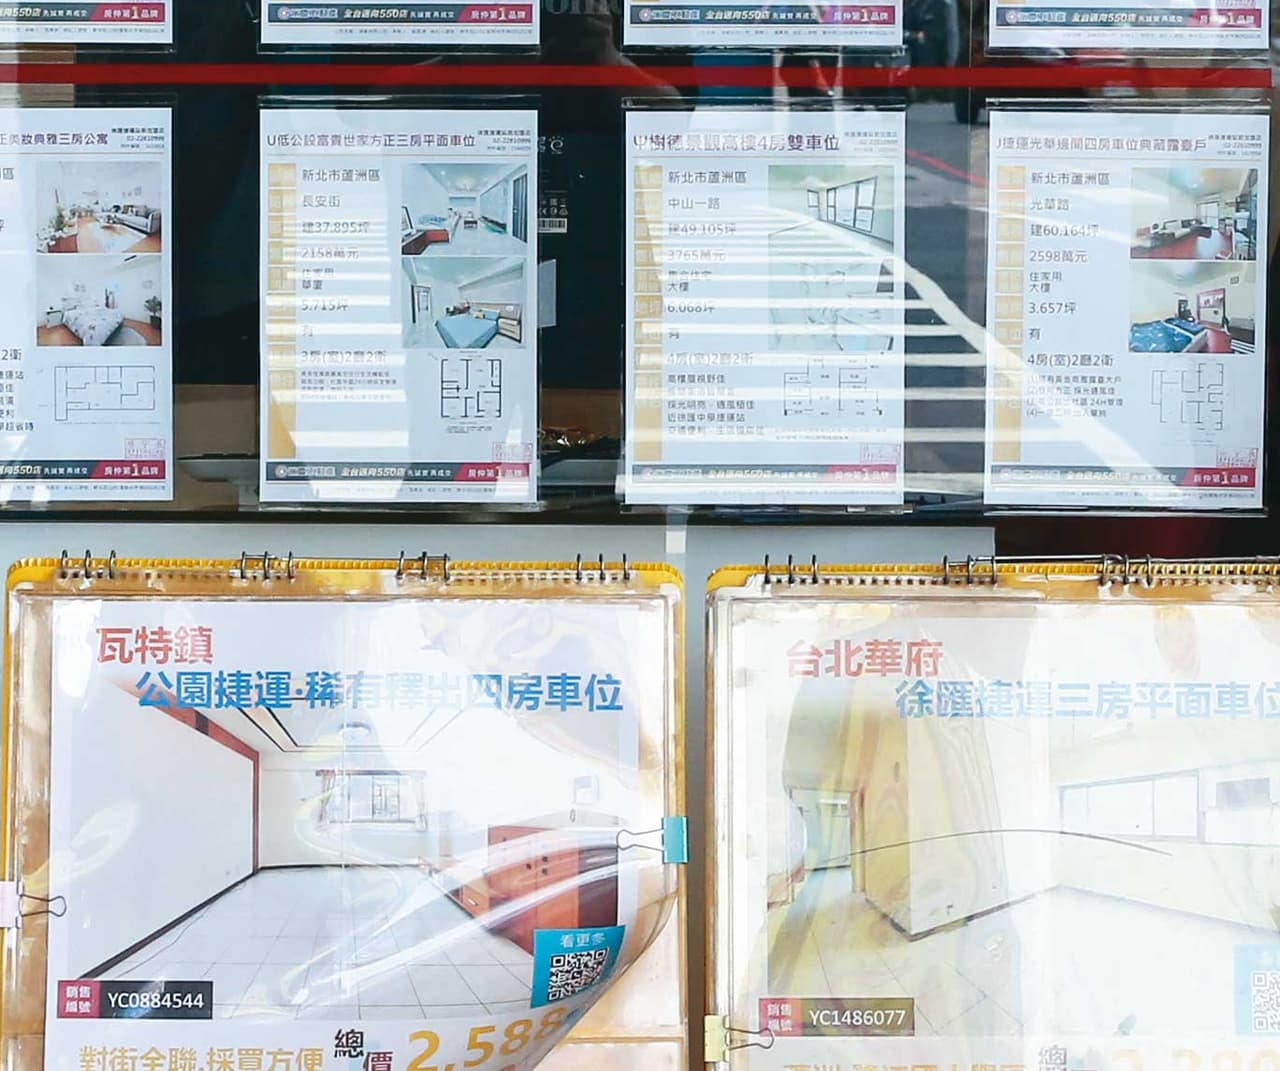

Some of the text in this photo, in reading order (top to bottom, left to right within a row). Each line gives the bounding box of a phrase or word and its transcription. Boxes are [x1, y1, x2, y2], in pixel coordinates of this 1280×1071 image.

[302, 169, 380, 182] 新北市蘆洲區
[668, 171, 746, 184] 新北市蘆洲區
[1031, 173, 1110, 185] 新北市蘆洲區
[668, 197, 720, 209] 中山一路
[1030, 199, 1069, 211] 光華路
[1030, 251, 1087, 263] 2598萬元
[1028, 302, 1076, 315] 3.657坪
[1027, 354, 1113, 367] 4房(室)2廳2衛
[97, 626, 214, 665] 瓦特鎮
[785, 639, 944, 678] 台北華府
[107, 992, 204, 1010] YC0884544
[808, 1008, 906, 1026] YC1486077
